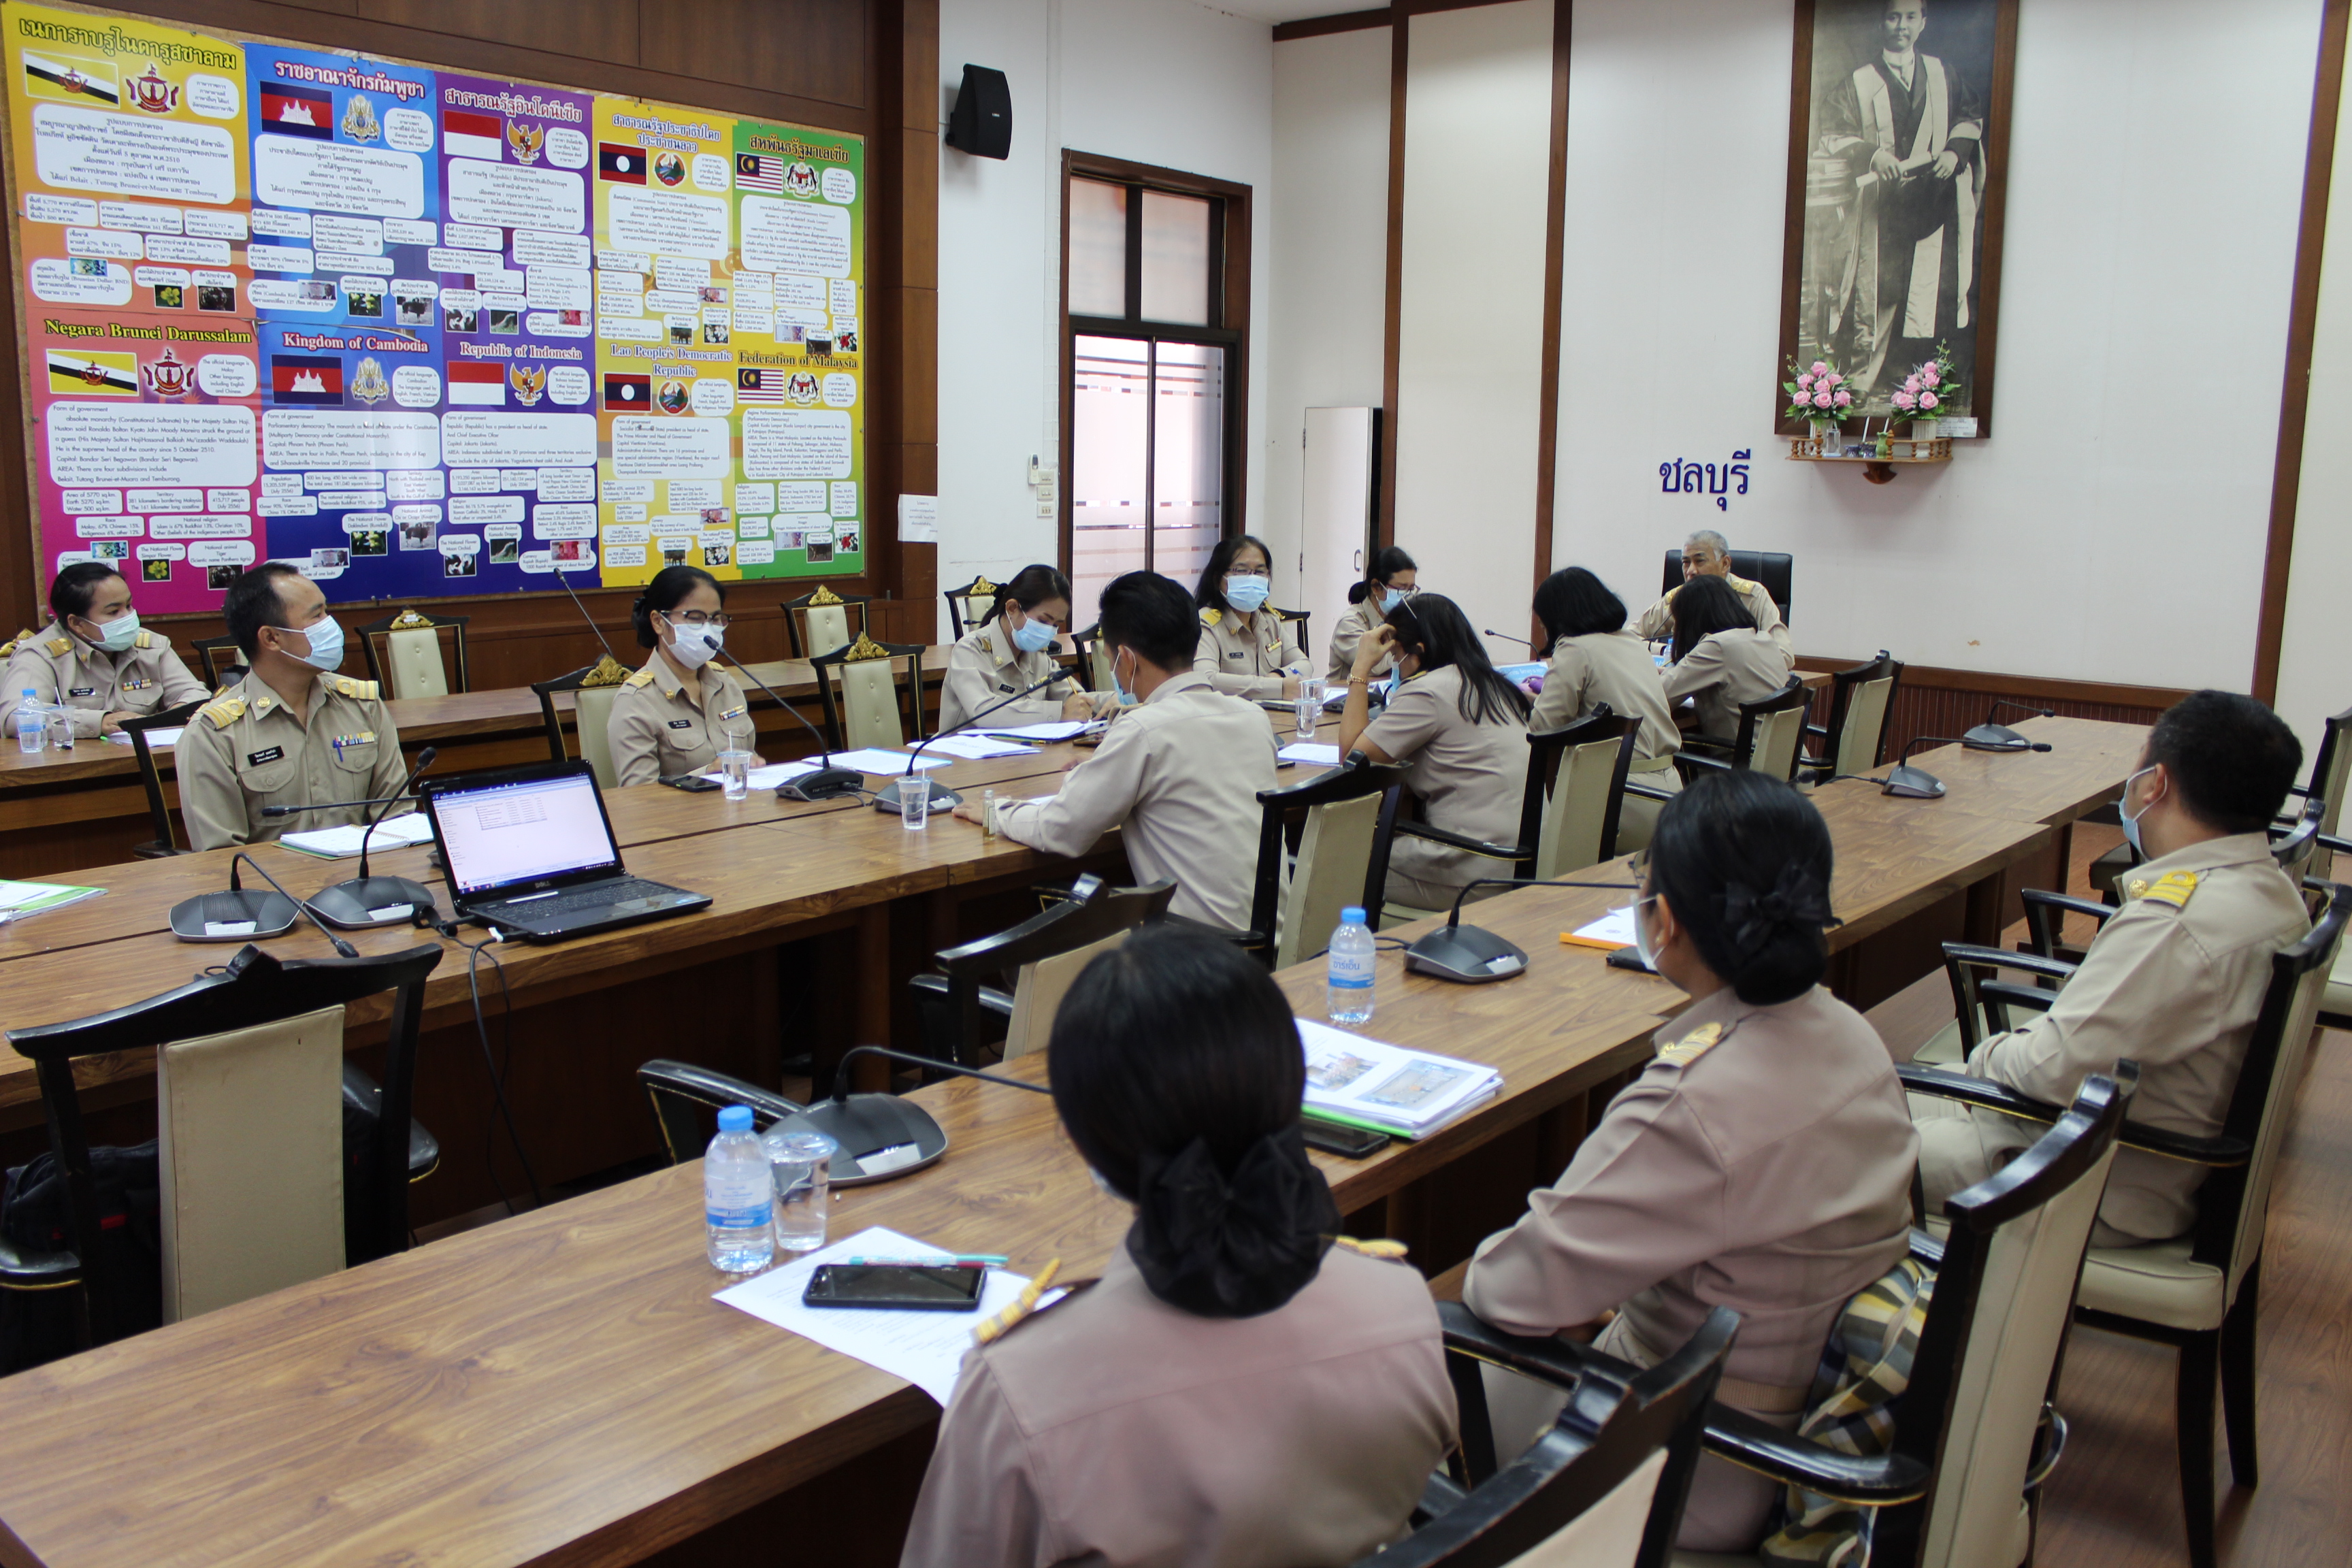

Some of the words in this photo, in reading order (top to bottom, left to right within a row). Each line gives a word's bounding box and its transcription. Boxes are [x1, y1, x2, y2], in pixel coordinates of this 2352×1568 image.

[20, 18, 236, 69] เนการาบรูไนดารุสซาลาม
[275, 61, 425, 101] ราชอาณาจักรกัมพูชา
[445, 88, 583, 123] สาธารณรัฐอินโดนีเซีย
[612, 114, 721, 142] สาธารณรัฐประชาธิปไตย
[637, 132, 698, 152] ประชาชนลาว
[750, 134, 849, 163] สหพันธรัฐมาเลเซีย
[45, 319, 104, 338] Negara
[109, 323, 162, 340] Brunei
[167, 326, 252, 343] Darussalam
[282, 333, 344, 350] Kingdom
[348, 336, 362, 350] of
[366, 337, 429, 353] Cambodia
[460, 342, 512, 359] Republic
[514, 344, 527, 357] of
[529, 345, 583, 359] Indonesia
[610, 344, 631, 357] Lao
[634, 344, 674, 361] People's
[677, 347, 732, 361] Democratic
[653, 363, 696, 378] Republic
[738, 351, 796, 366] Federation
[799, 353, 811, 366] of
[814, 355, 858, 370] Malaysia
[90, 415, 116, 424] monarchy
[182, 416, 190, 425] by
[1659, 448, 1751, 512] ชลบุรี
